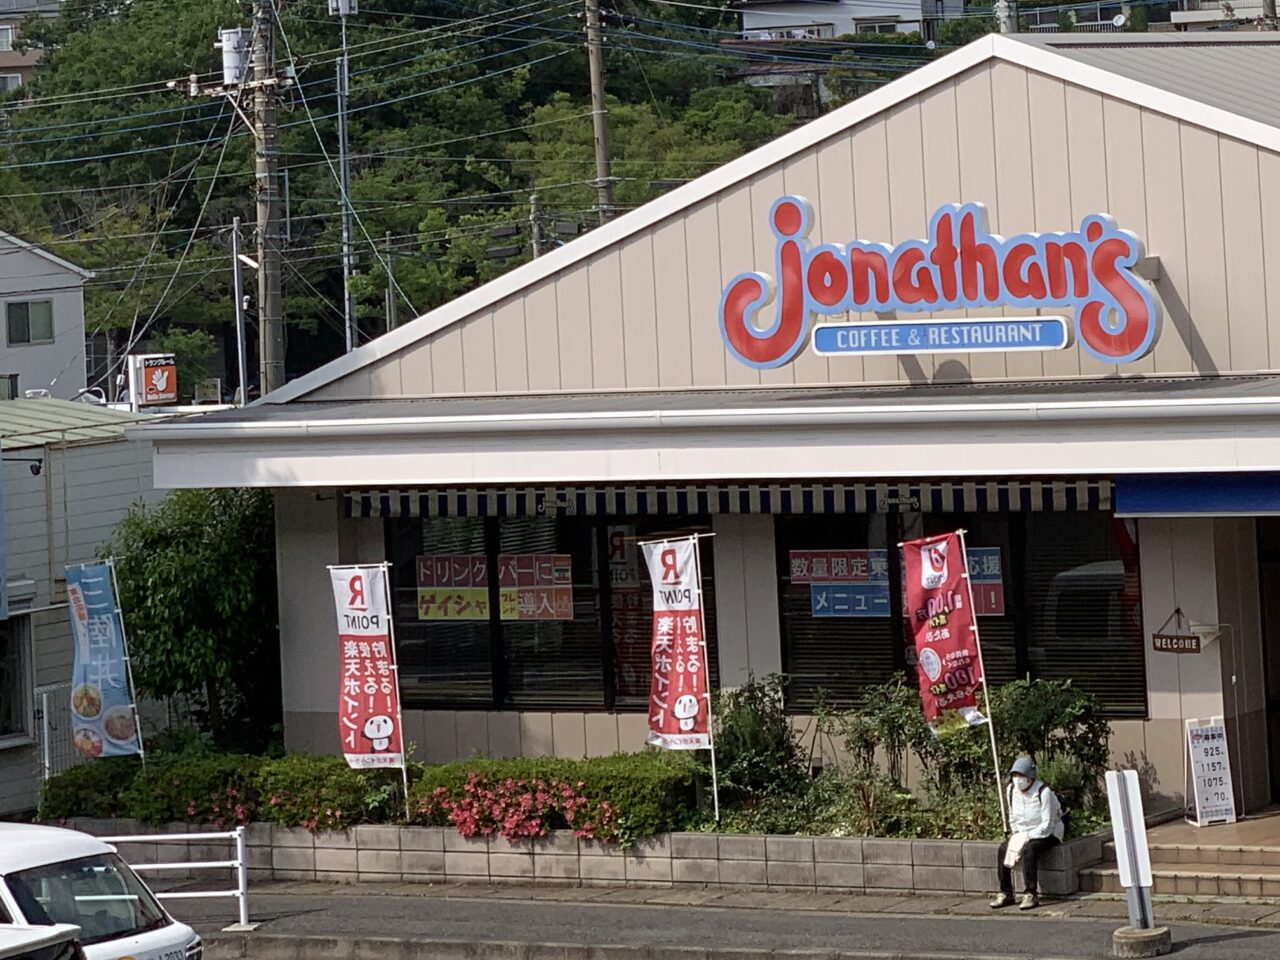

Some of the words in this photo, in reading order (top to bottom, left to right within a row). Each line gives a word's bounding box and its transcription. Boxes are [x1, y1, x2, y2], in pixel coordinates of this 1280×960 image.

[836, 328, 901, 348] COFFEE
[907, 328, 921, 346] &
[929, 323, 1043, 345] RESTAURANT
[419, 560, 487, 583] ドリンク
[499, 559, 553, 582] バーに
[419, 593, 488, 616] ゲイシャ
[815, 591, 888, 611] メニュー
[1154, 638, 1198, 649] WELCOME
